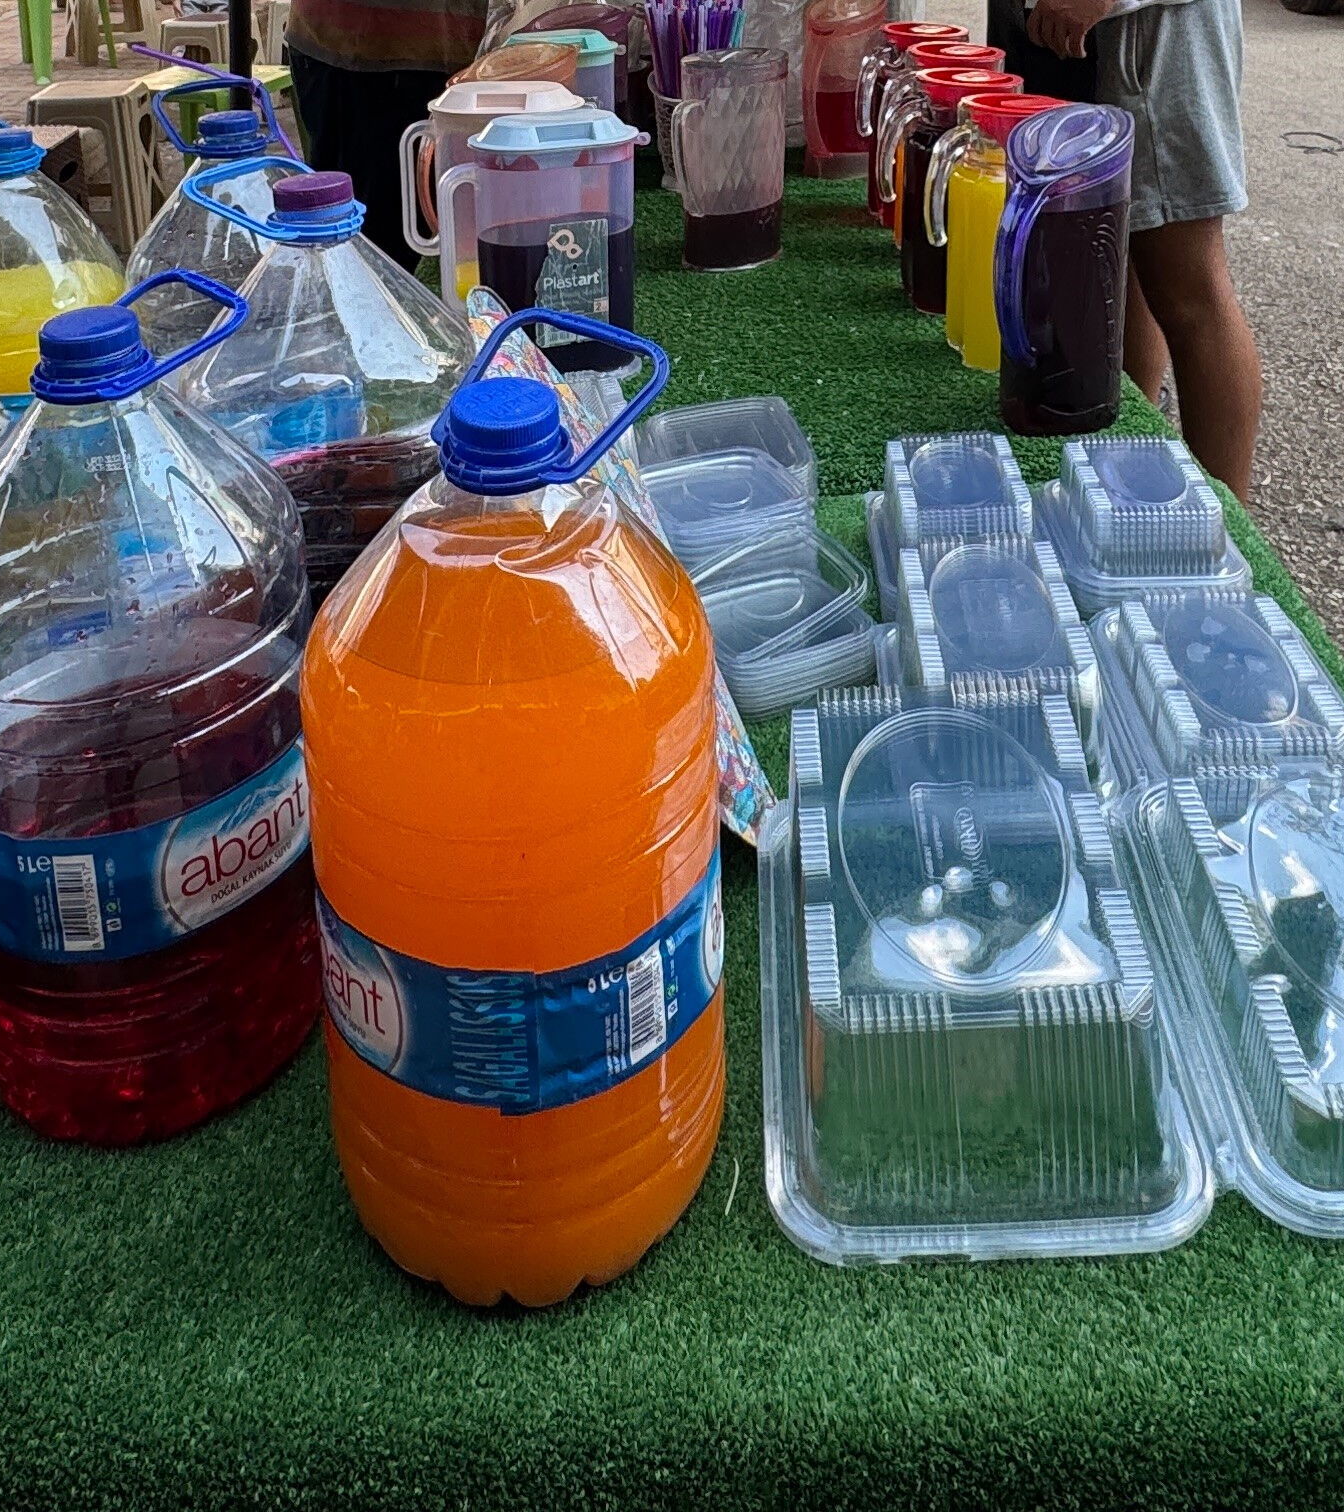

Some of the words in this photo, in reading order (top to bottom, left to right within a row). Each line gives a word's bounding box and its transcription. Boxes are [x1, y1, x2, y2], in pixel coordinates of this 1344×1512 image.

[543, 271, 600, 290] Plastart
[181, 778, 304, 896] abant
[445, 975, 531, 1104] SAGALASSOS
